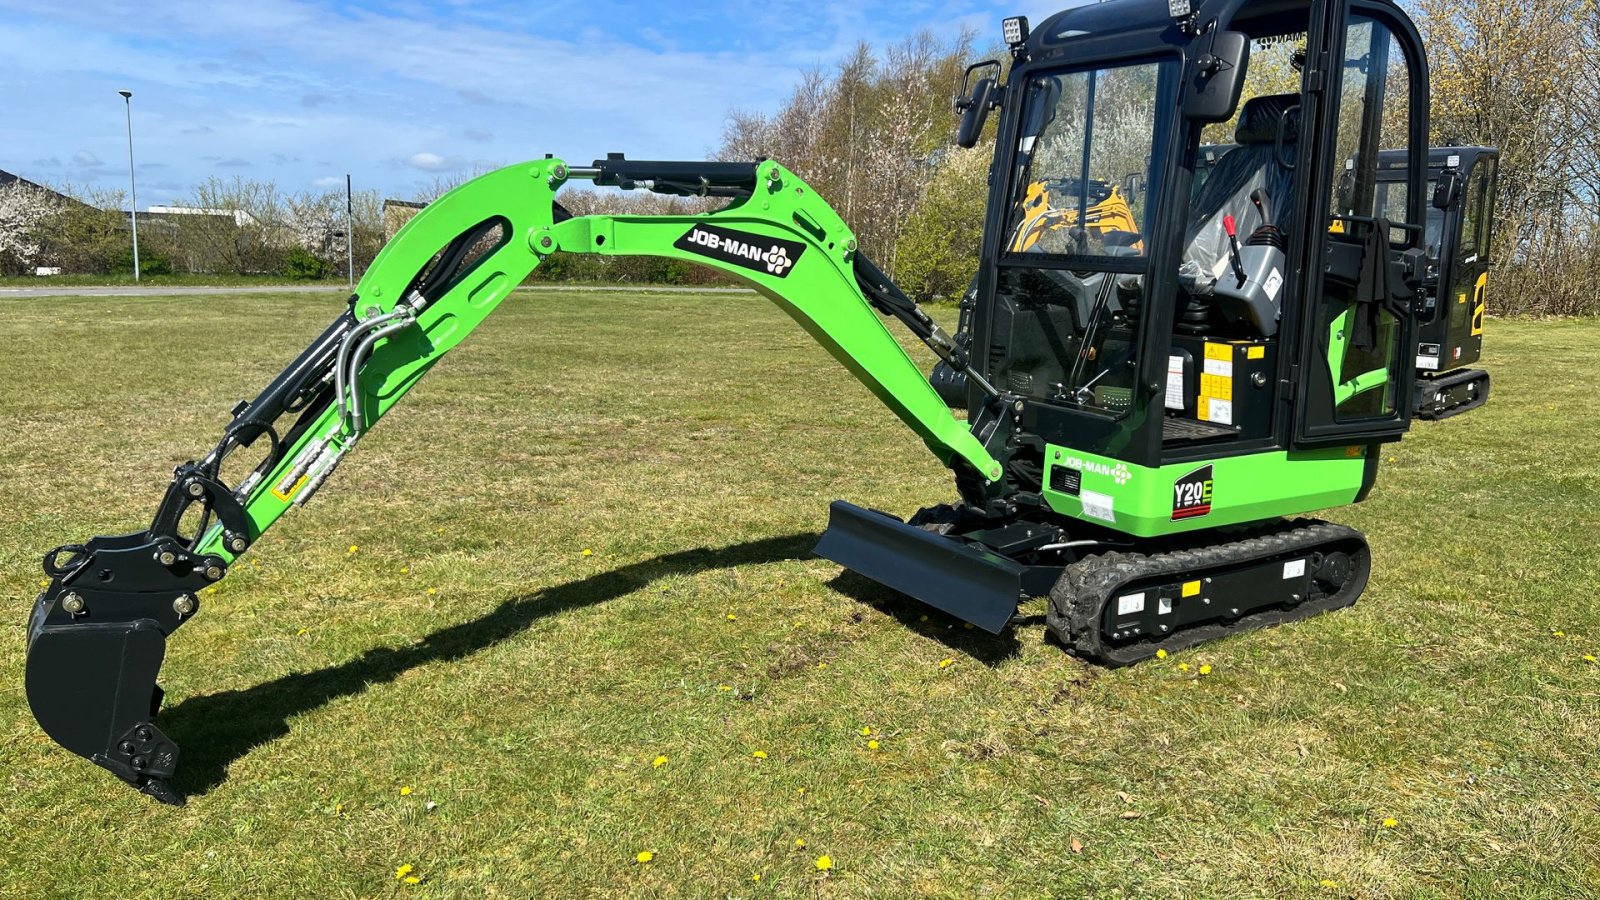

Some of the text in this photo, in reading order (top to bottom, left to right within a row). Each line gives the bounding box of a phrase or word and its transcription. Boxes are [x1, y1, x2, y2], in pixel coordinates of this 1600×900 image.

[687, 228, 762, 261] JOB-MAN
[1064, 456, 1110, 476] JOB-MAN
[1175, 480, 1212, 501] Y20E
